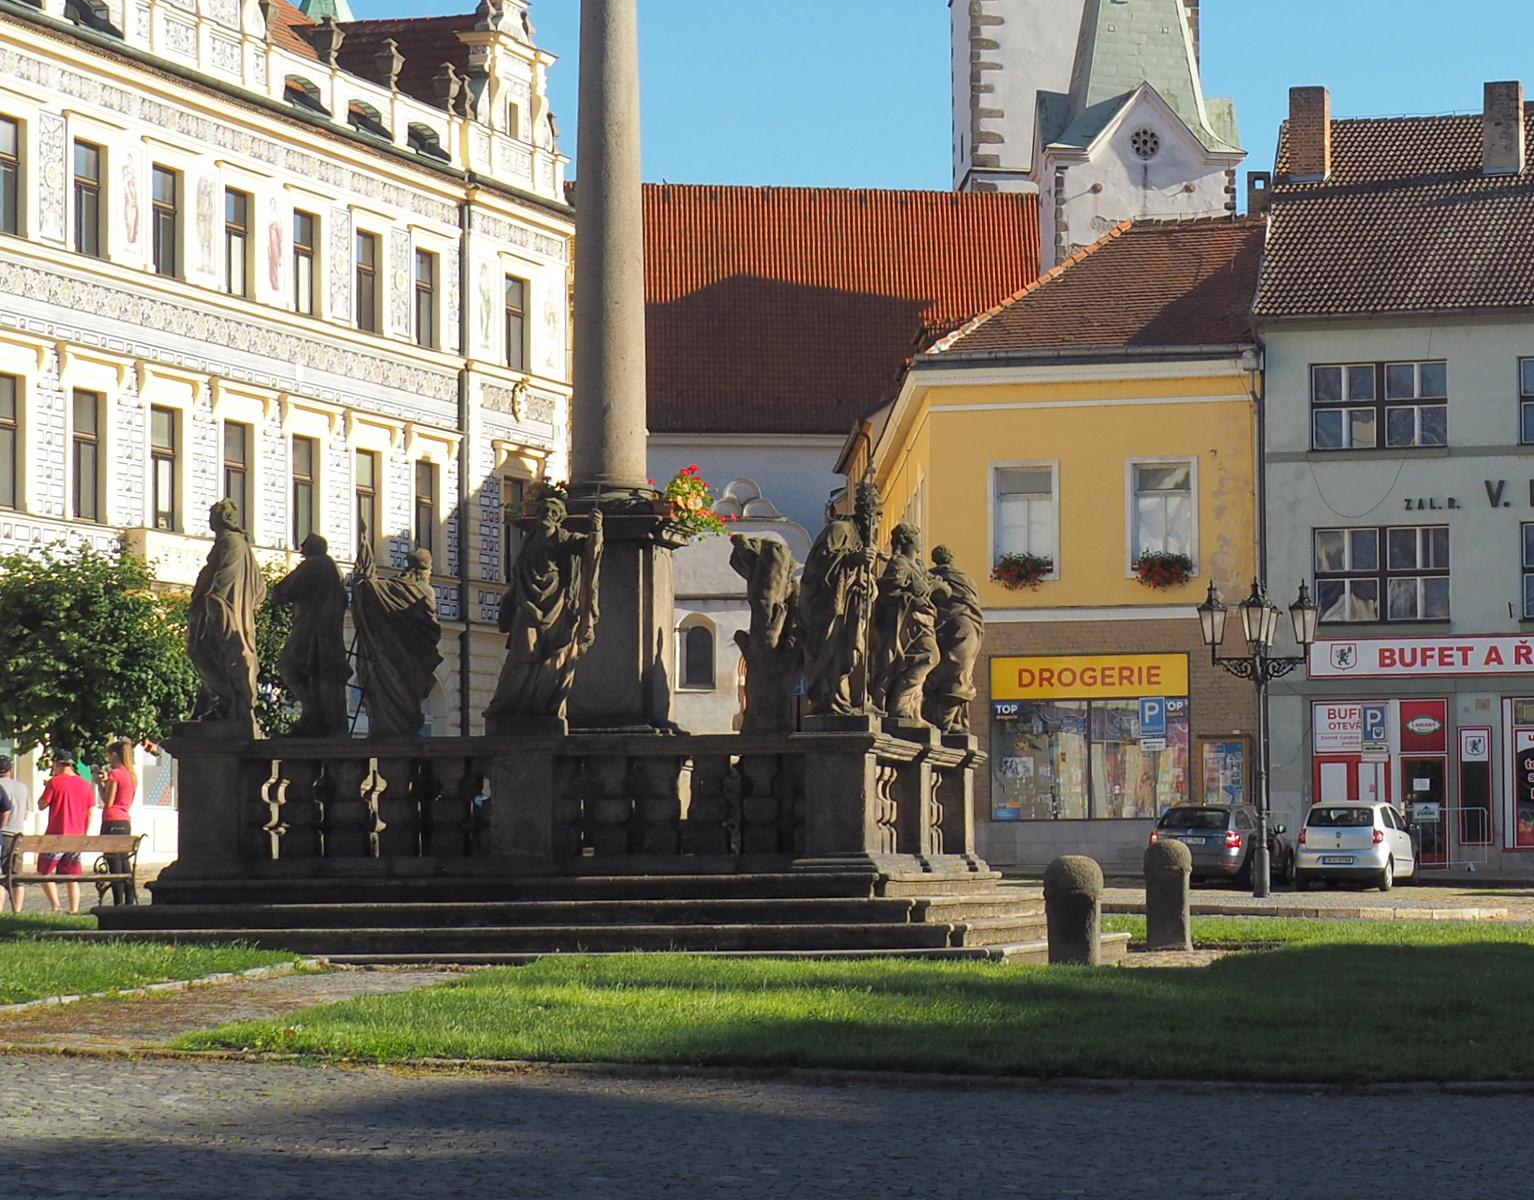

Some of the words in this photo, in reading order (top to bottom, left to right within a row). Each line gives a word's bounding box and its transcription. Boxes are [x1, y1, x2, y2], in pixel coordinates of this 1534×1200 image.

[1404, 498, 1442, 510] ZAL.
[1484, 480, 1510, 508] V.
[1378, 646, 1474, 668] BUFET
[1483, 645, 1504, 666] A
[1018, 666, 1162, 688] DROGERIE
[995, 704, 1018, 714] TOP
[1144, 702, 1160, 724] P
[1328, 708, 1361, 720] BUF
[1366, 709, 1382, 731] P
